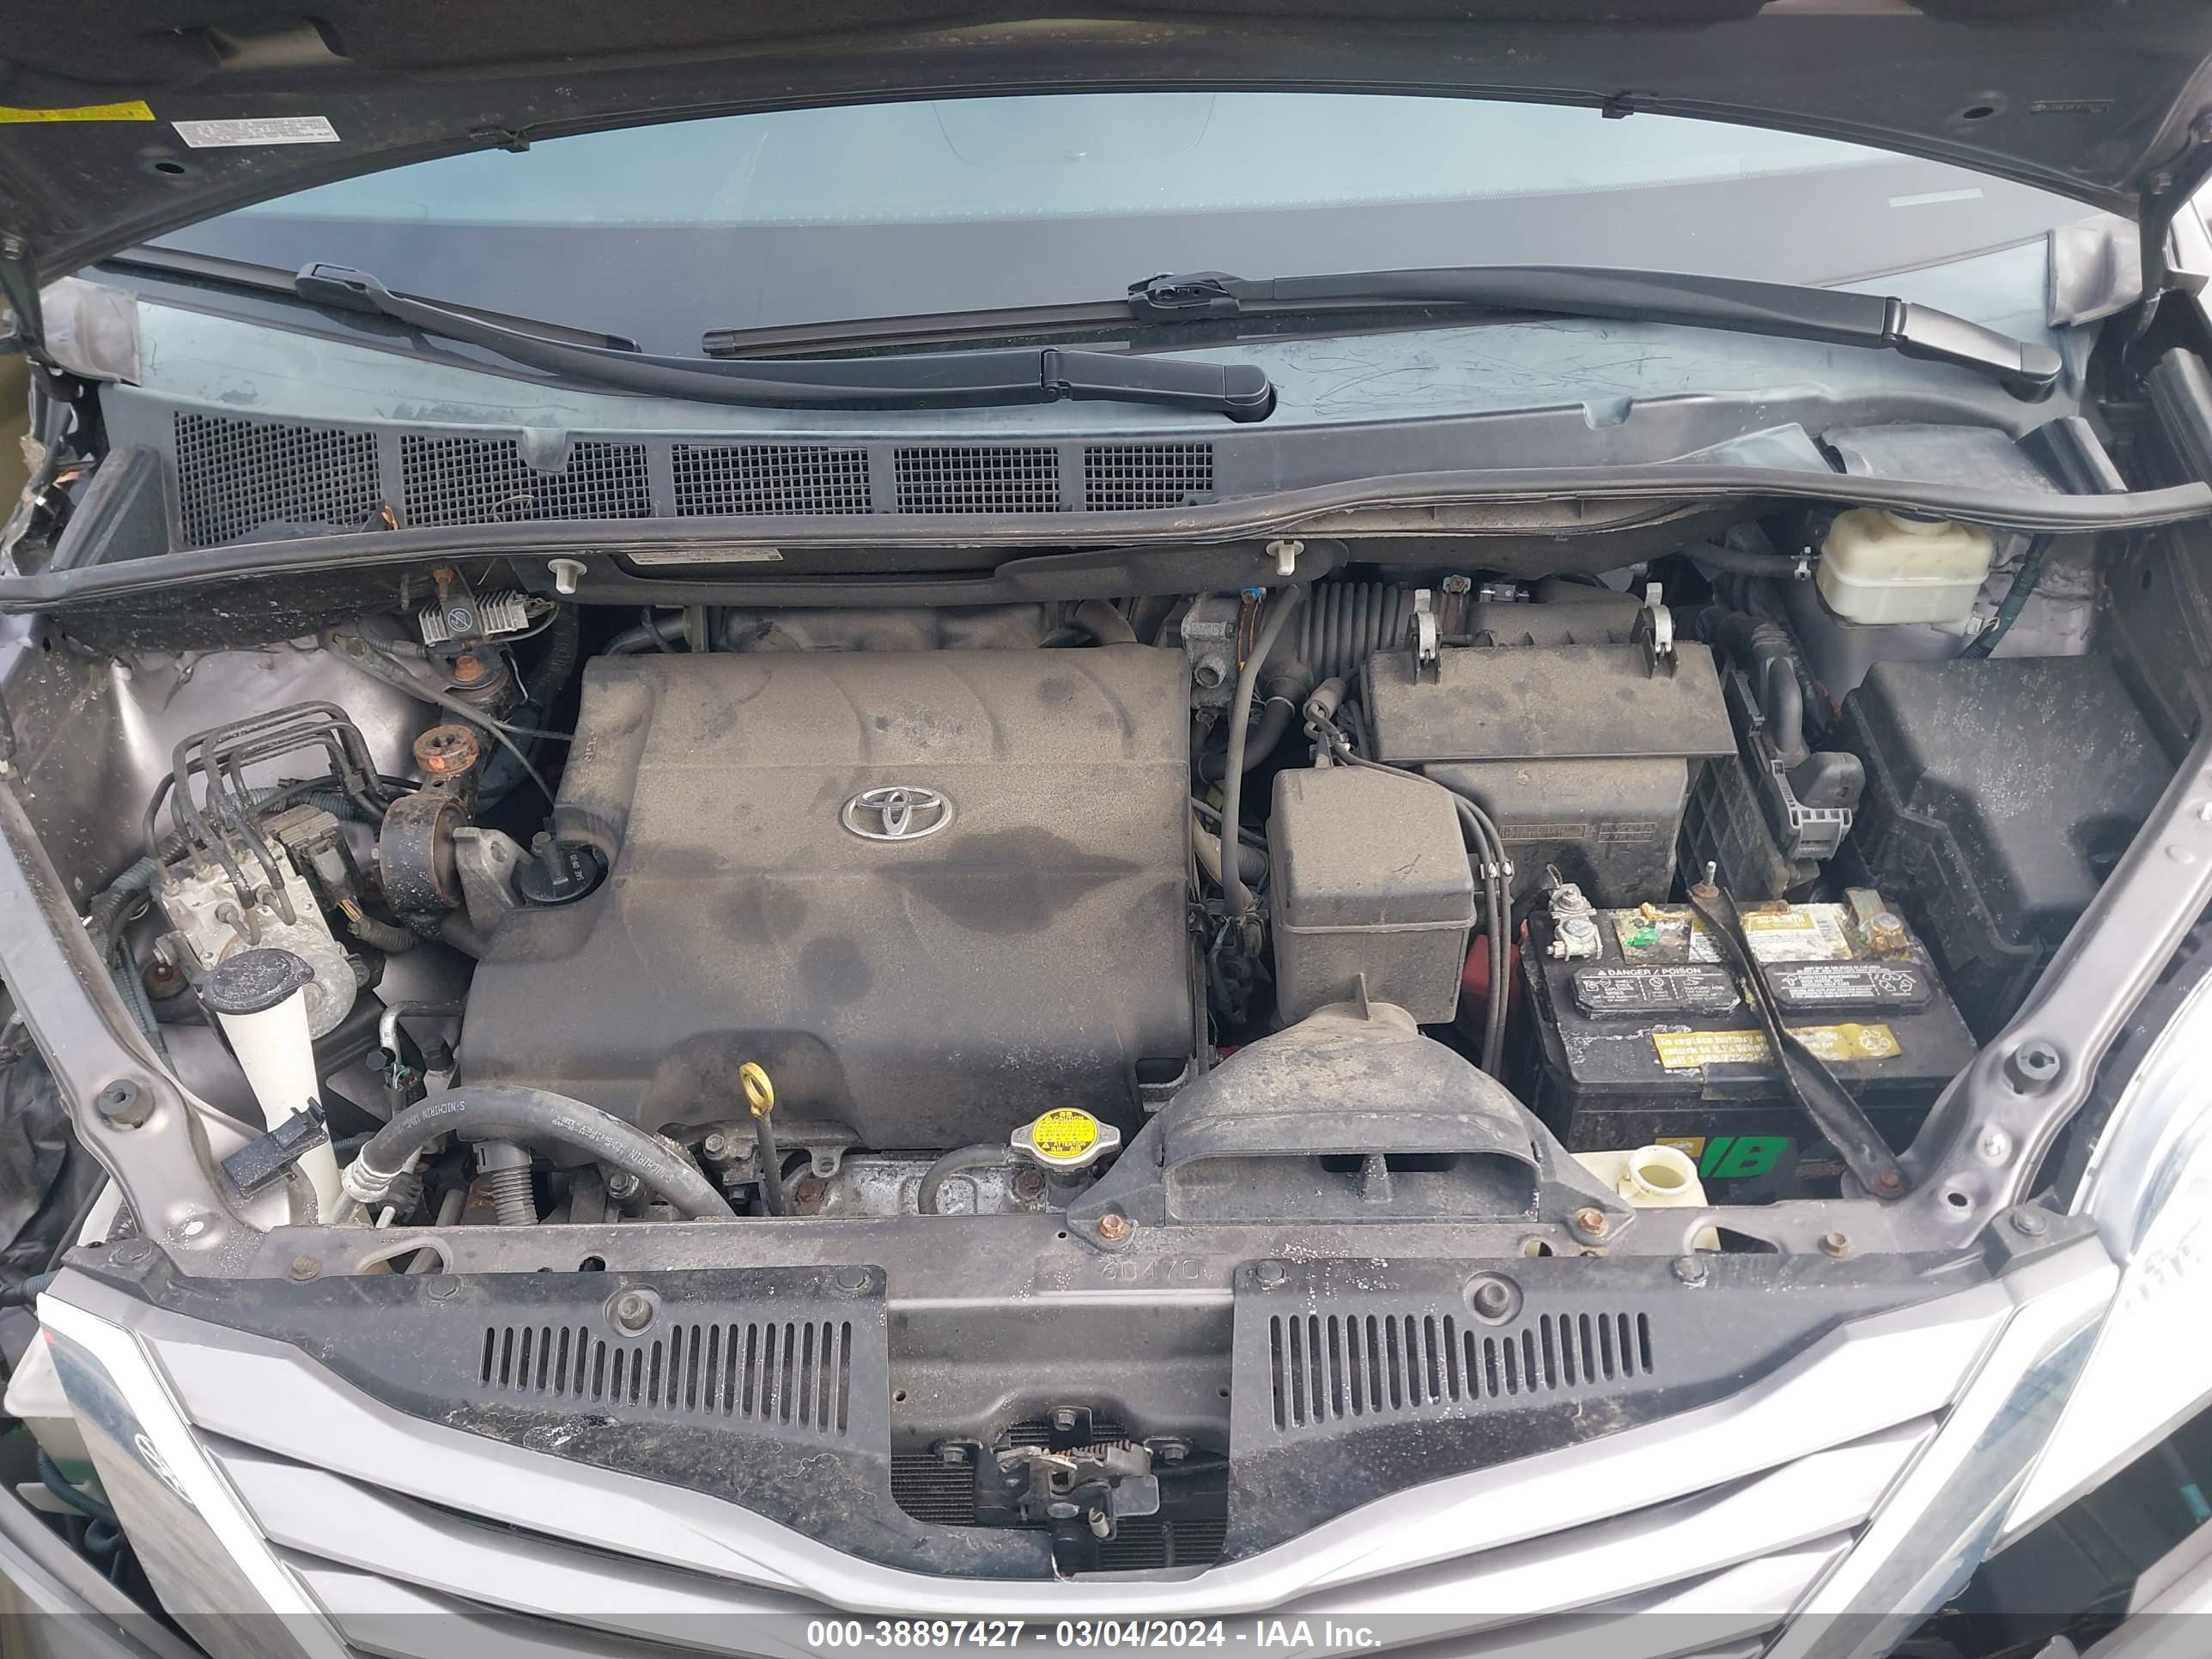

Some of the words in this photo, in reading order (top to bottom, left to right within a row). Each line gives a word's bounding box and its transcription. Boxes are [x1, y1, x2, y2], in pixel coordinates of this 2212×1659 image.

[1674, 1036, 1713, 1046] replace
[1715, 1035, 1753, 1044] battery
[1662, 1046, 1698, 1054] return
